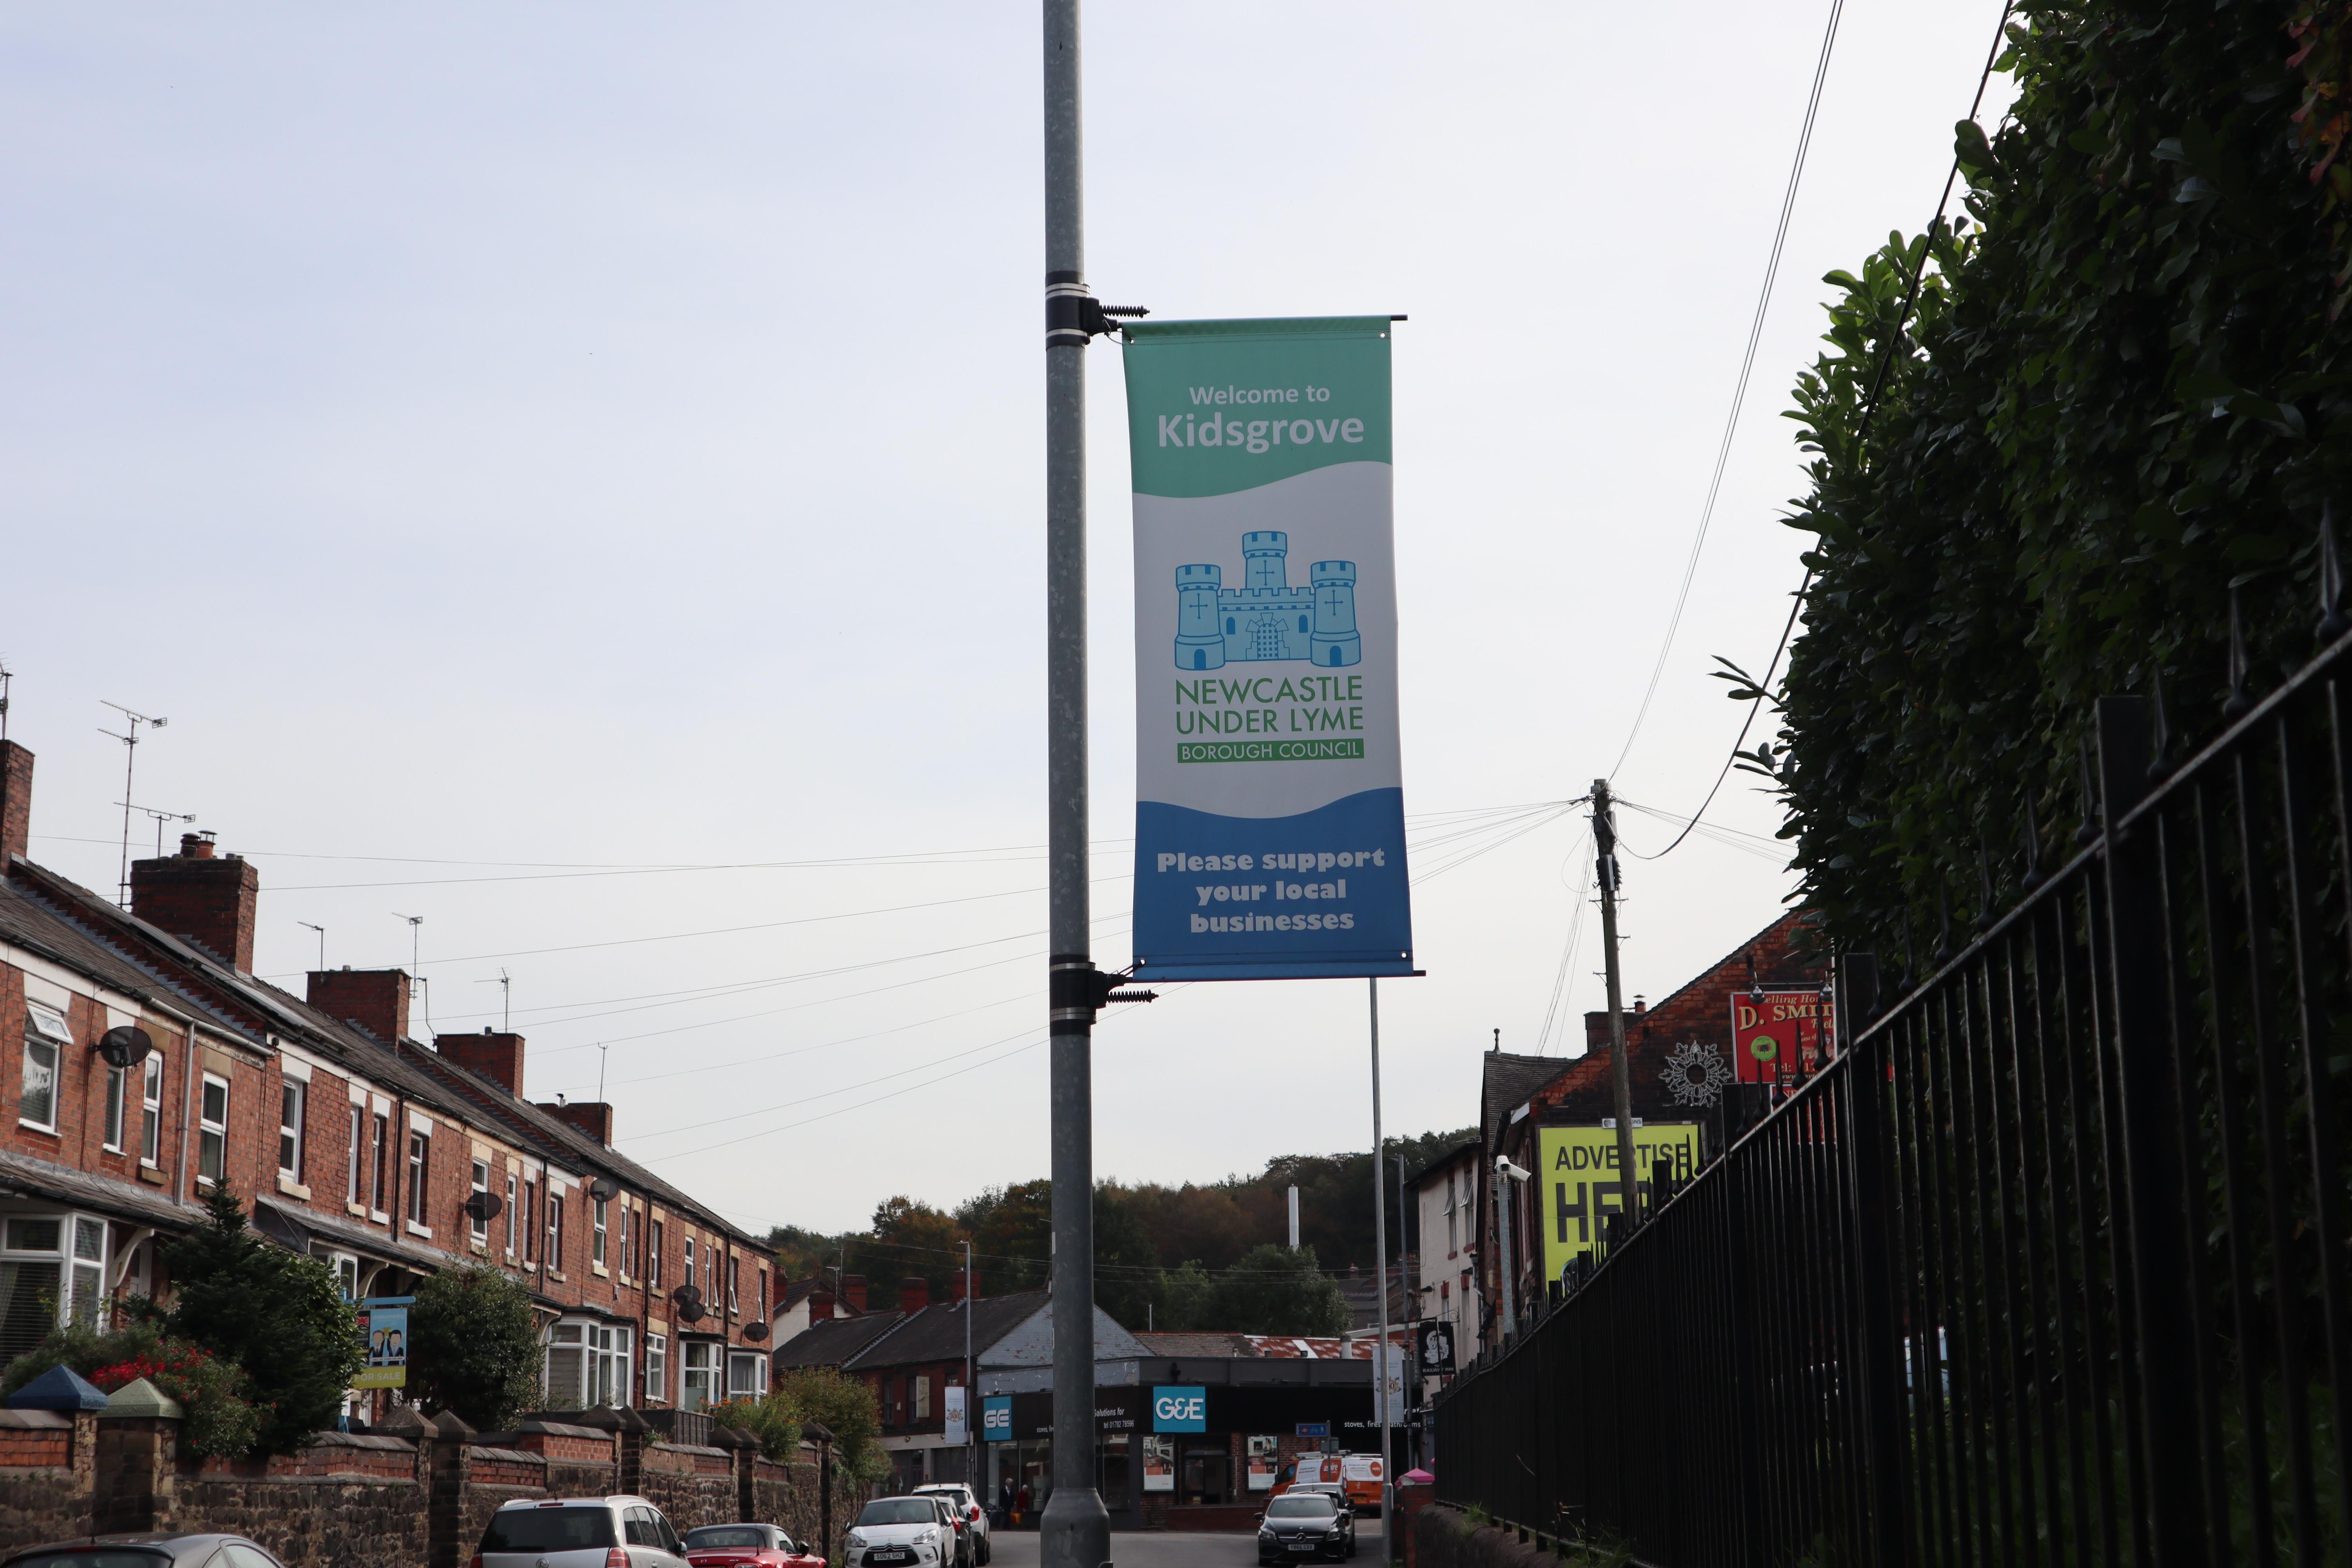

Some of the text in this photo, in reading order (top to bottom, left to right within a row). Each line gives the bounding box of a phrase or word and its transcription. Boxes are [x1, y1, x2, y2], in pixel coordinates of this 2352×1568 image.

[1189, 385, 1330, 405] Welcome to
[1158, 412, 1364, 454] Kidsgrove
[1176, 675, 1363, 705] NEWCASTLE
[1176, 706, 1363, 734] UNDER LYME
[1181, 741, 1360, 760] BOROUGH COUNCIL
[1158, 848, 1385, 873] Please support
[1196, 879, 1346, 906] your local
[1191, 912, 1354, 933] businesses
[1739, 1006, 1765, 1031] D.
[1555, 1143, 1688, 1171] ADVETISE
[377, 1372, 401, 1381] SALE
[1156, 1397, 1204, 1420] G&E
[1109, 1421, 1121, 1429] 01782
